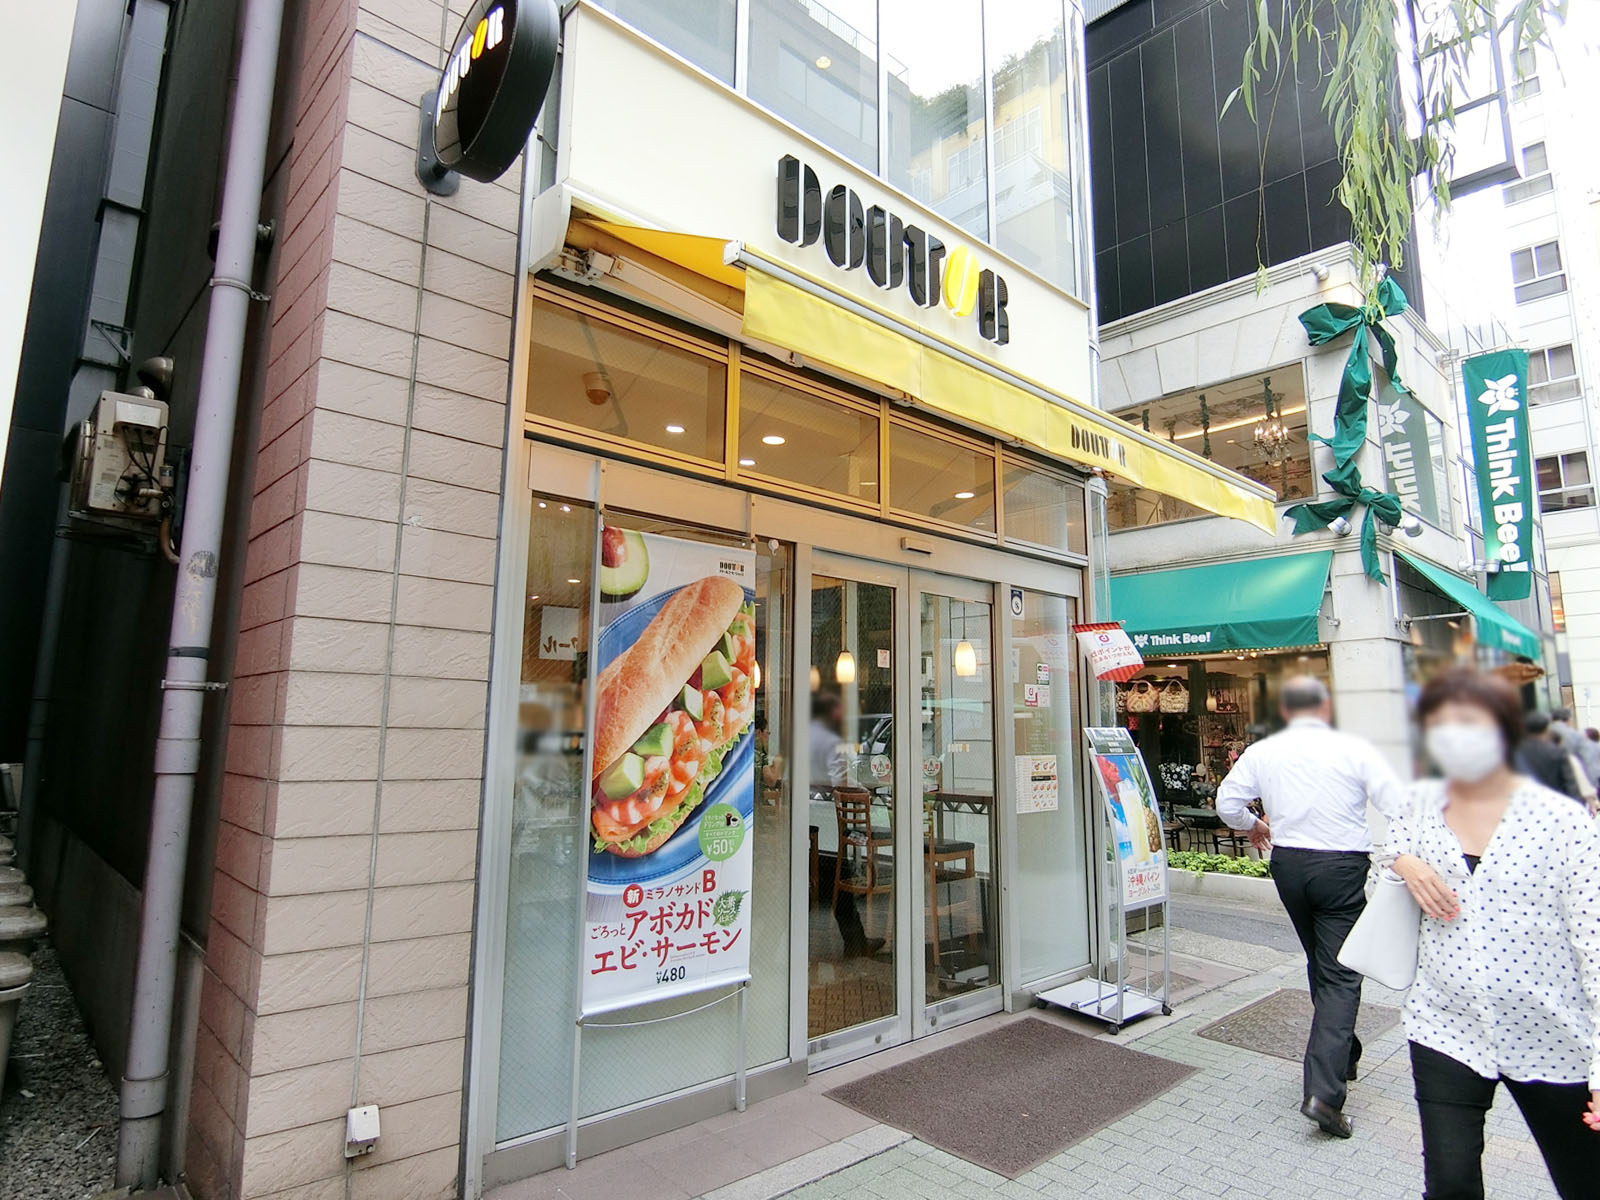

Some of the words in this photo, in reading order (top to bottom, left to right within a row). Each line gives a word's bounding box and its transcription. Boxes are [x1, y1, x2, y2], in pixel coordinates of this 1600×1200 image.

[777, 154, 1010, 346] DOUTOR
[1071, 424, 1126, 468] DOUTOR
[1485, 417, 1520, 501] Think
[1493, 502, 1530, 572] Bee!
[1150, 633, 1181, 646] Think
[1182, 632, 1211, 644] Bee!
[626, 887, 640, 904] 新
[591, 928, 742, 975] エビ・サーモン
